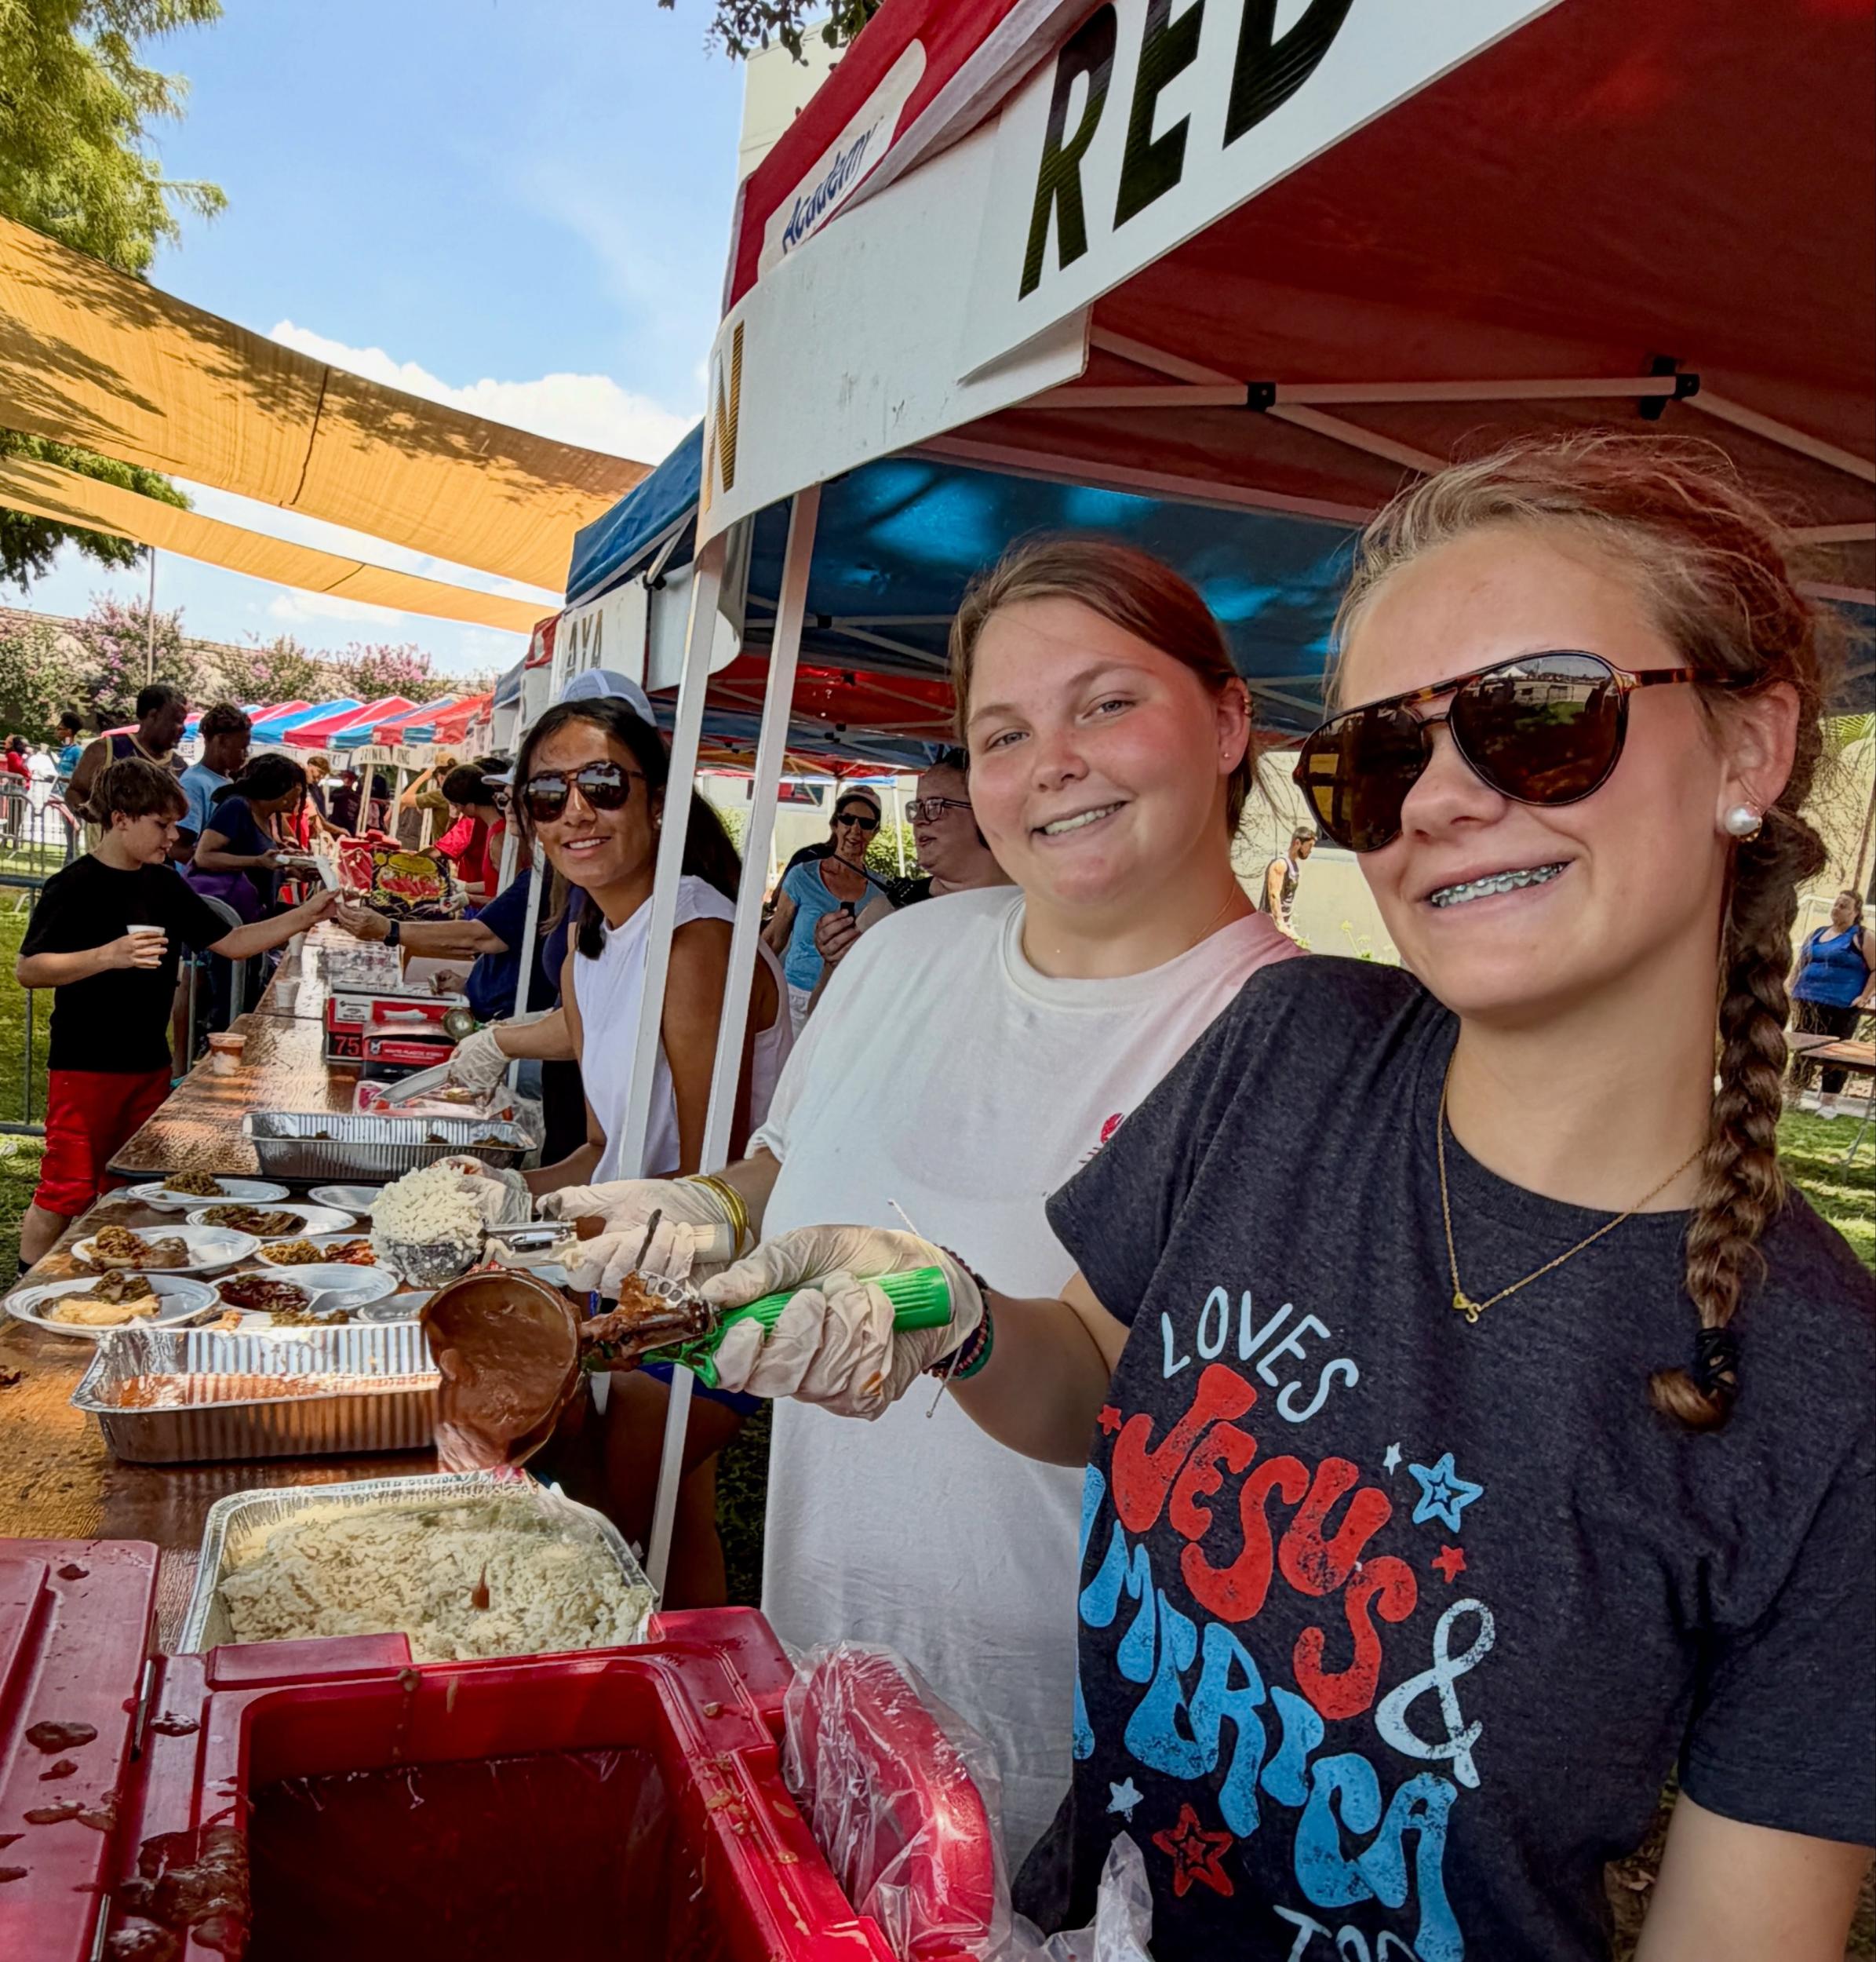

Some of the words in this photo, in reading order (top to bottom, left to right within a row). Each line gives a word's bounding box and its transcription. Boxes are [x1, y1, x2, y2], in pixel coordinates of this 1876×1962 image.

[782, 122, 879, 256] Academy
[1018, 0, 1356, 302] RED
[334, 1035, 360, 1056] 75
[1162, 1286, 1359, 1423] LOVES
[1112, 1362, 1418, 1720] JESUS
[1375, 1598, 1495, 1787] &
